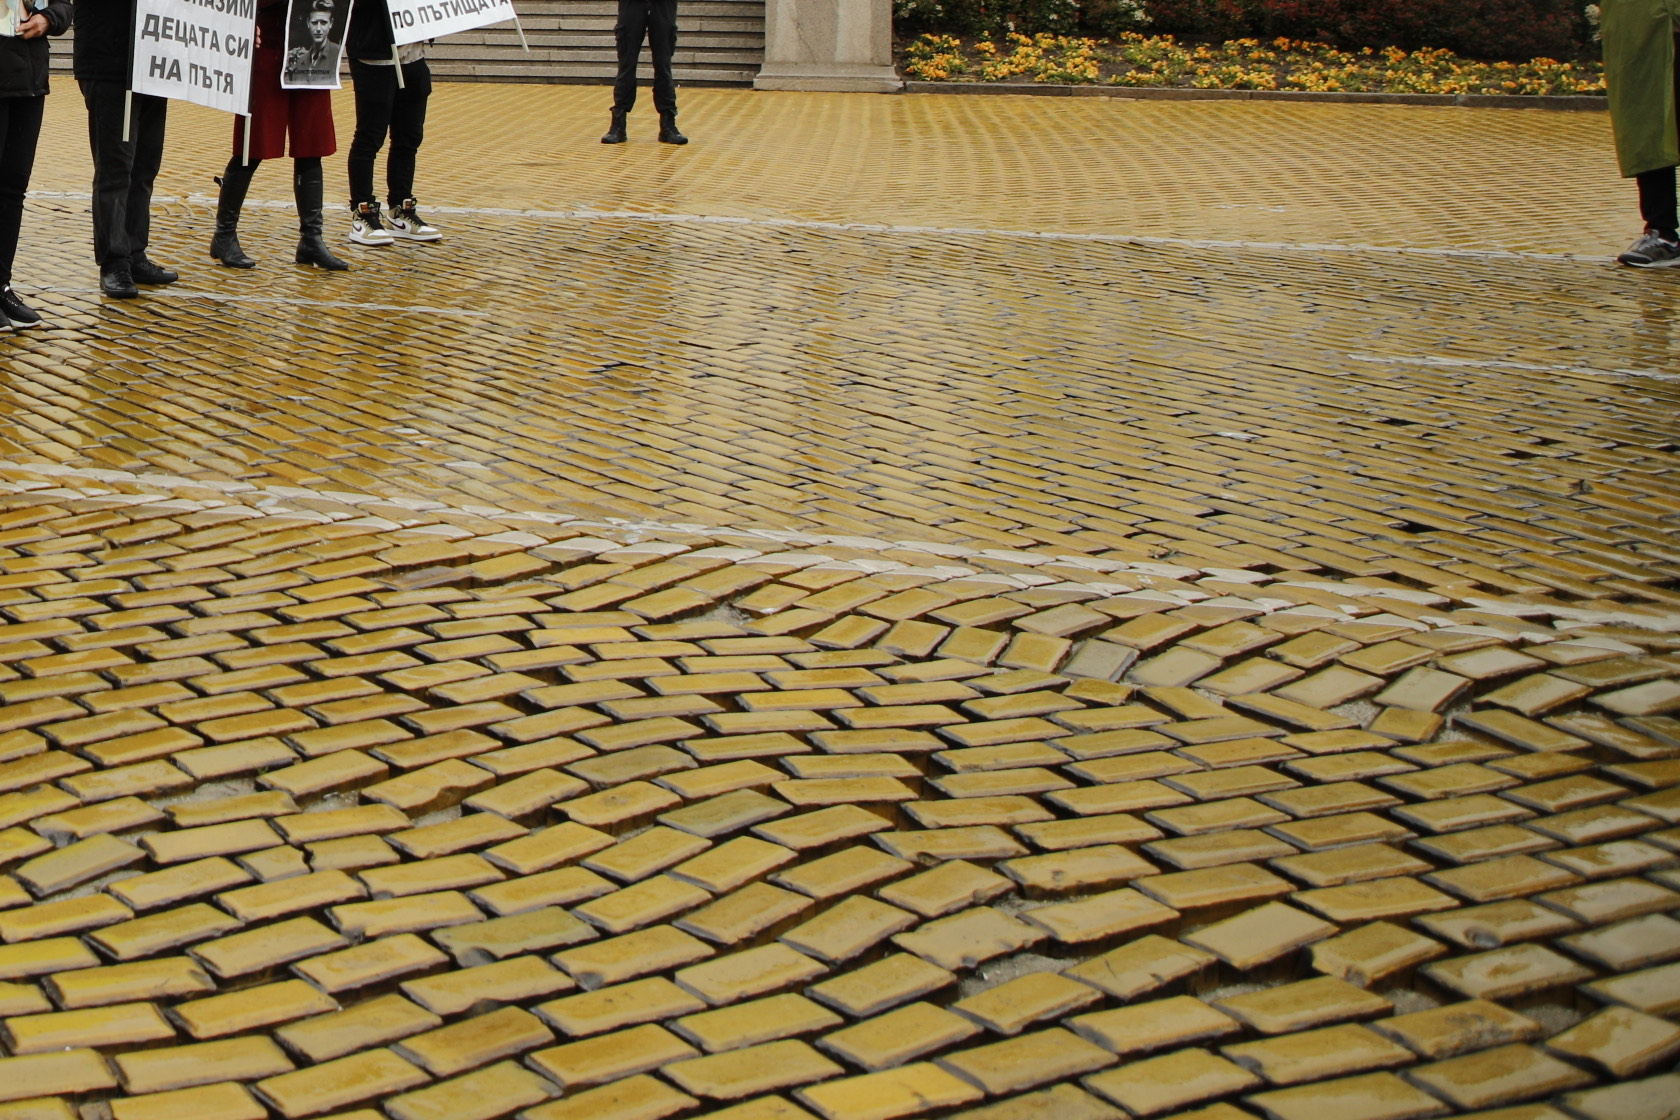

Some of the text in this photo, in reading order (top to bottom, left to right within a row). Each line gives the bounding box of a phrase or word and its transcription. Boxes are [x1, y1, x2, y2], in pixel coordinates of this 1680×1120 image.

[141, 13, 250, 60] ДЕЦАТА СИ
[391, 9, 415, 30] ПО
[148, 55, 234, 95] НА ПЪТЯ
